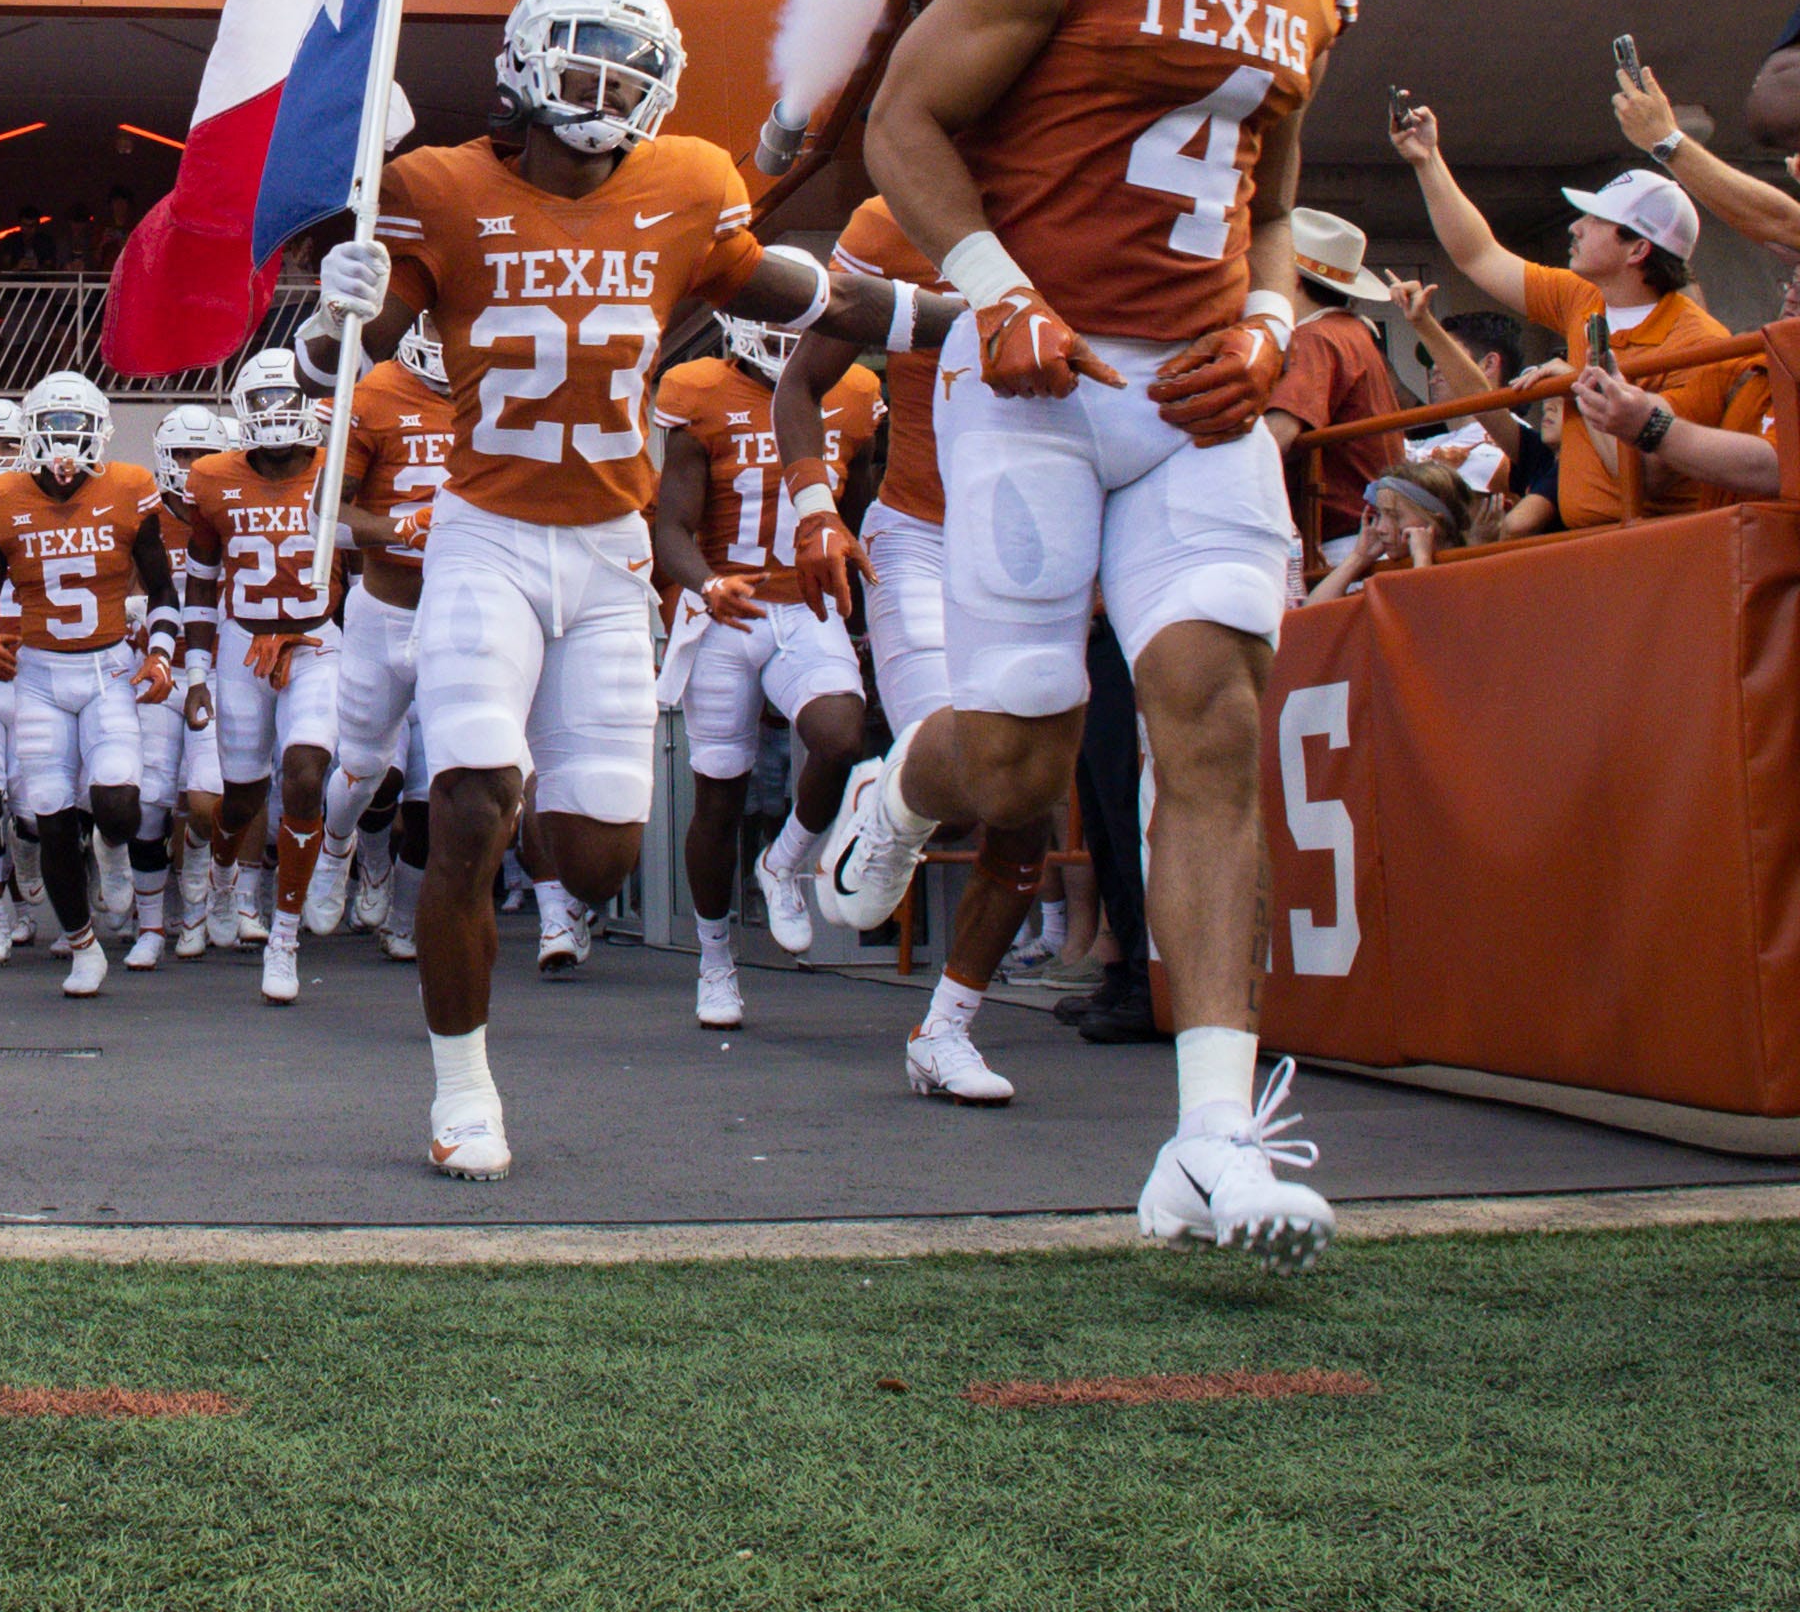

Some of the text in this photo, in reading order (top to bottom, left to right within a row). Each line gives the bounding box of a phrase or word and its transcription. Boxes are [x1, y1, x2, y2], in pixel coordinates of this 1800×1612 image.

[1125, 65, 1274, 260] 4
[484, 249, 659, 299] TEXAS
[470, 304, 663, 464] 23
[731, 430, 842, 465] TES
[18, 524, 115, 559] TEXAS
[228, 506, 310, 533] TEXA
[42, 554, 99, 640] 5
[228, 534, 331, 620] 23
